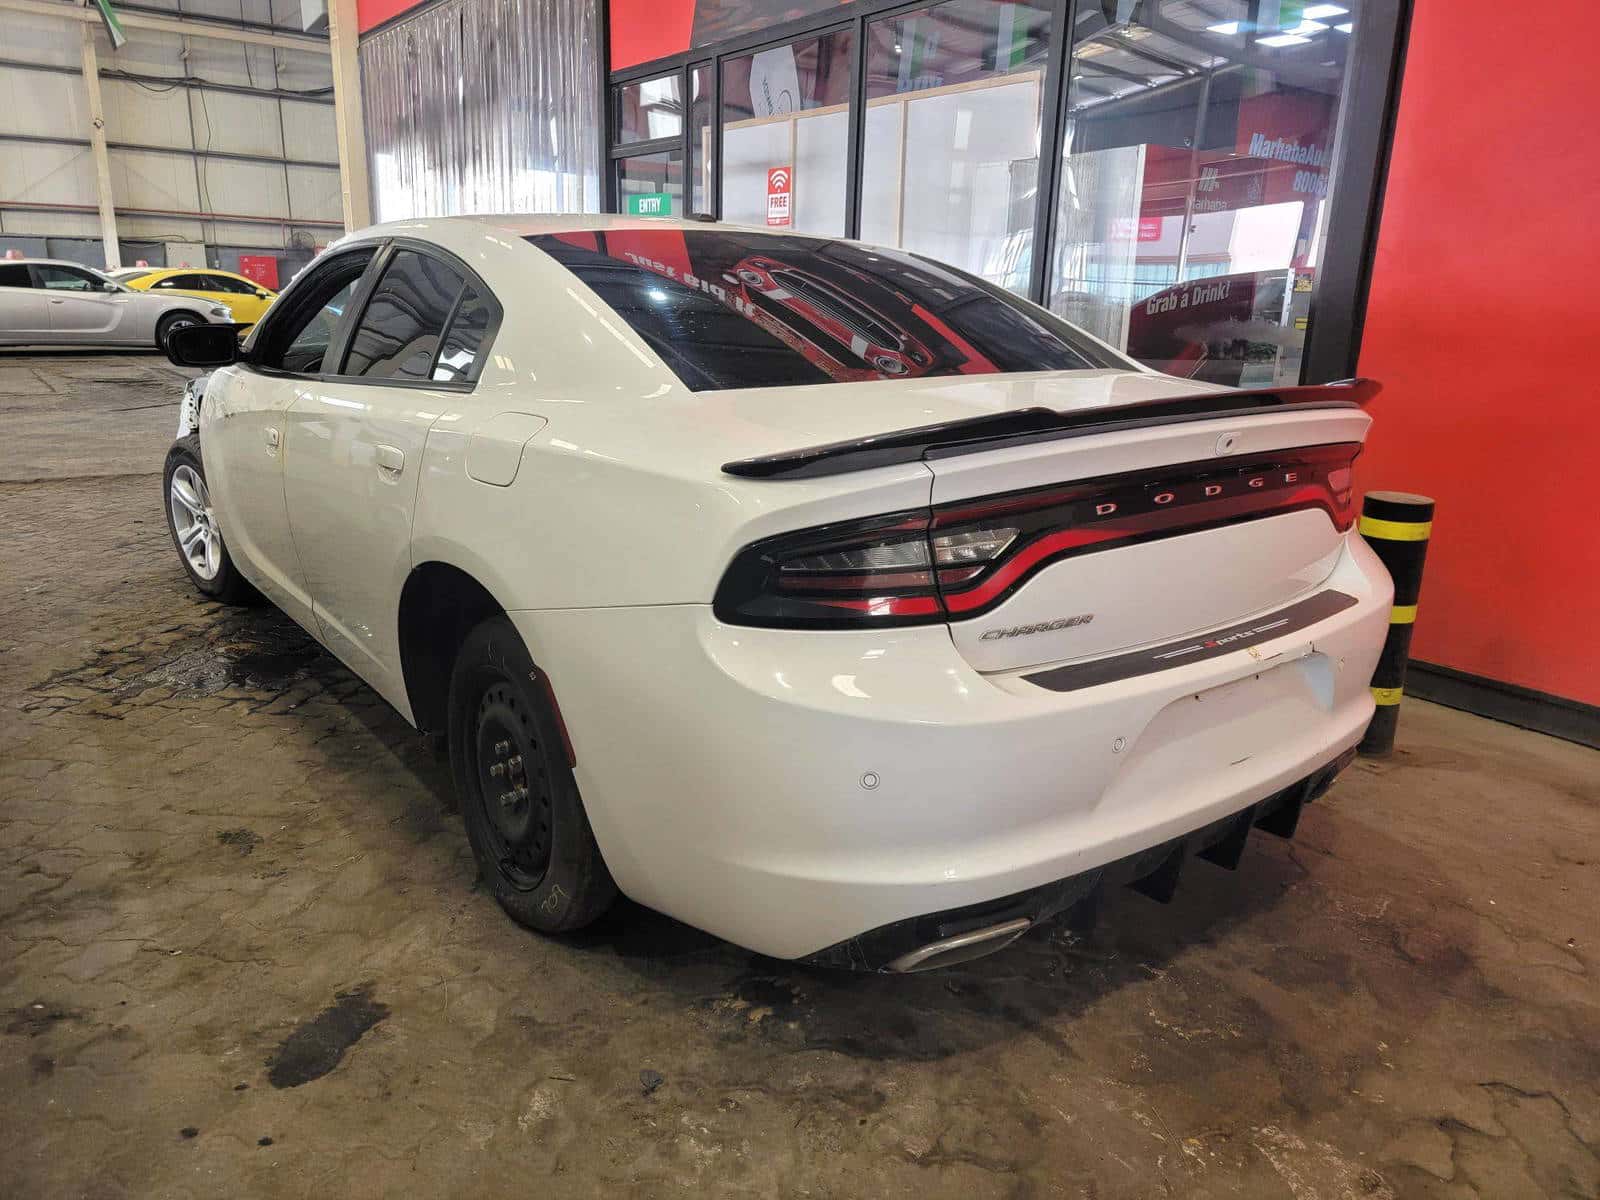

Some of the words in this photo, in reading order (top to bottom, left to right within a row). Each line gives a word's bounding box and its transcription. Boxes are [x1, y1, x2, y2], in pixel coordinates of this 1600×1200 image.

[638, 197, 662, 213] ENTRY
[770, 196, 788, 208] FREE
[1146, 292, 1177, 315] Grab
[1180, 293, 1188, 309] a
[1192, 280, 1231, 306] Drink!
[1095, 472, 1297, 516] DODGE
[977, 613, 1095, 640] CHARGER
[1204, 629, 1256, 648] Sports
